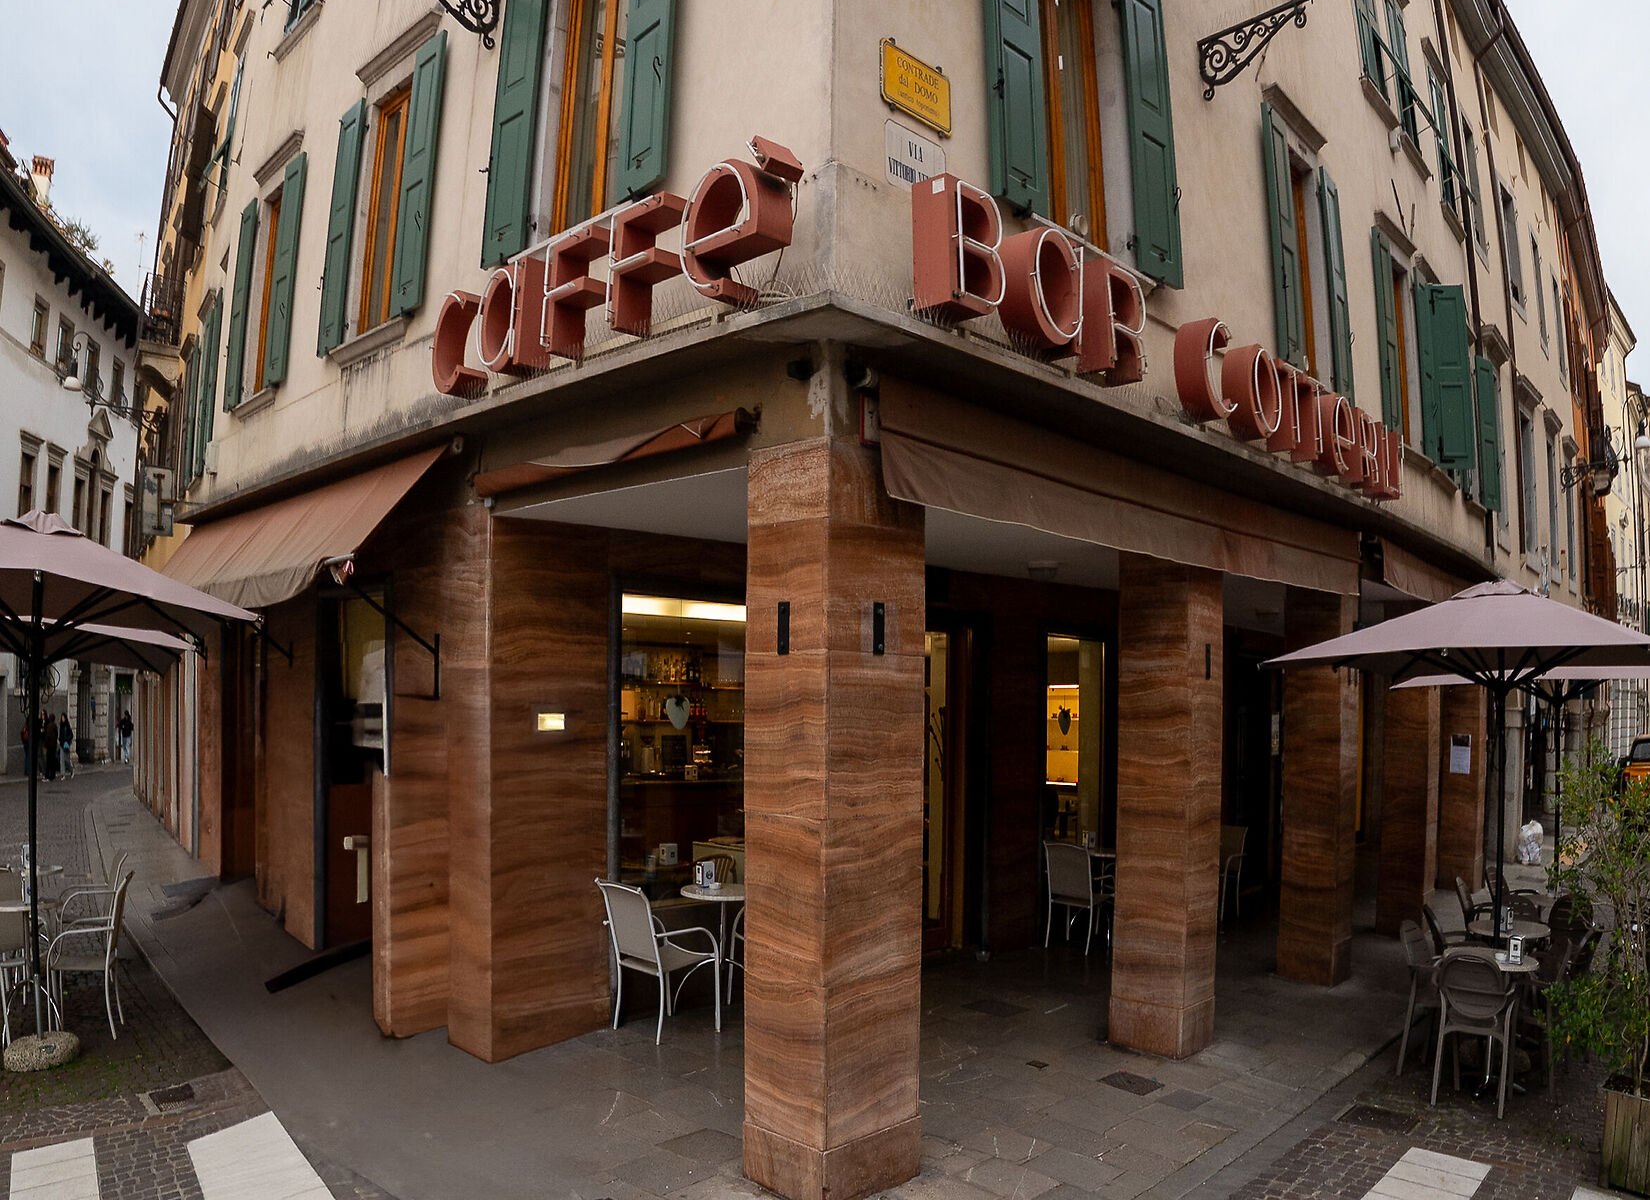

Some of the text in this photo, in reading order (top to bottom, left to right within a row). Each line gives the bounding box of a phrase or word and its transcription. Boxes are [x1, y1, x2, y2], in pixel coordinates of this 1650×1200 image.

[896, 56, 940, 91] CONTRADE
[914, 81, 939, 105] DOMO
[908, 140, 923, 163] VIA
[888, 156, 917, 184] VITTORIO
